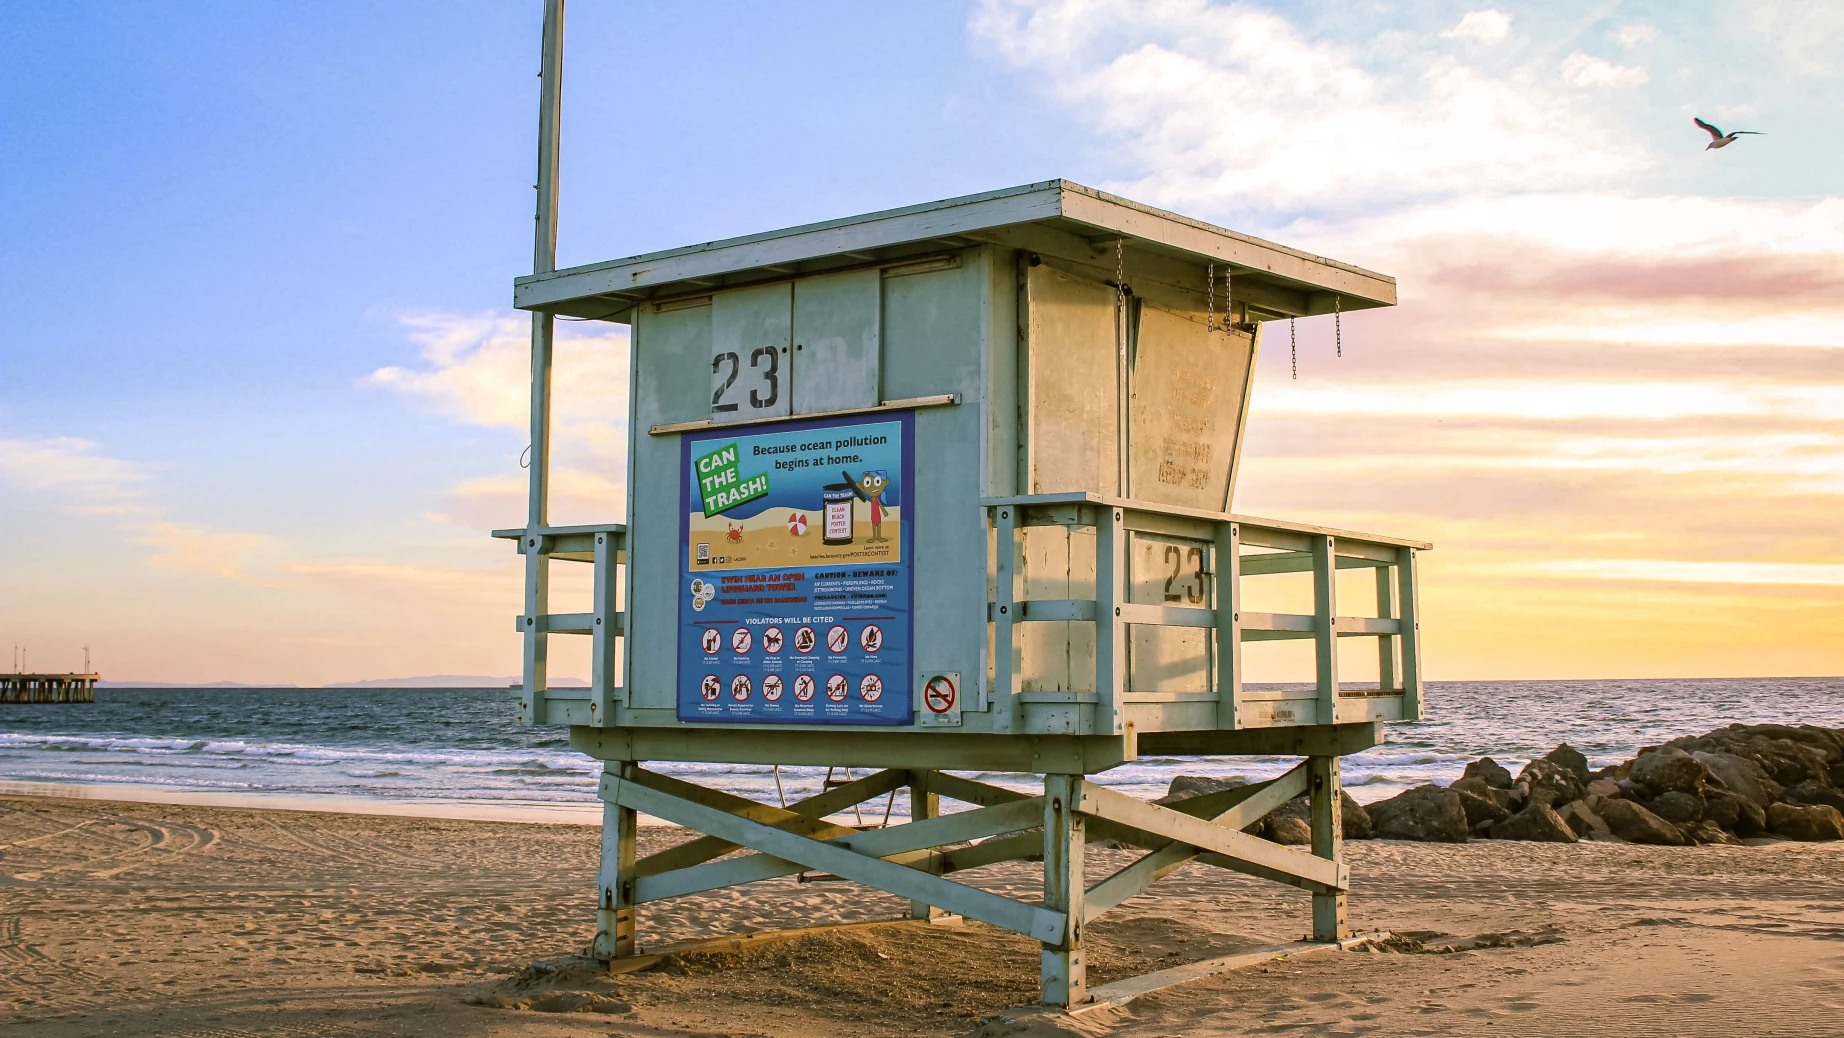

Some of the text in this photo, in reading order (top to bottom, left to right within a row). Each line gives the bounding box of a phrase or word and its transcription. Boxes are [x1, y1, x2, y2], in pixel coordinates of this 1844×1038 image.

[712, 346, 778, 413] 23
[753, 435, 886, 455] Because ocean pollution
[700, 448, 735, 472] CAN
[775, 455, 862, 471] begins at home.
[702, 468, 736, 492] THE
[706, 476, 766, 510] TRASH!
[768, 574, 780, 582] AN
[1165, 546, 1204, 604] 23
[722, 585, 764, 593] LIFEGUARD
